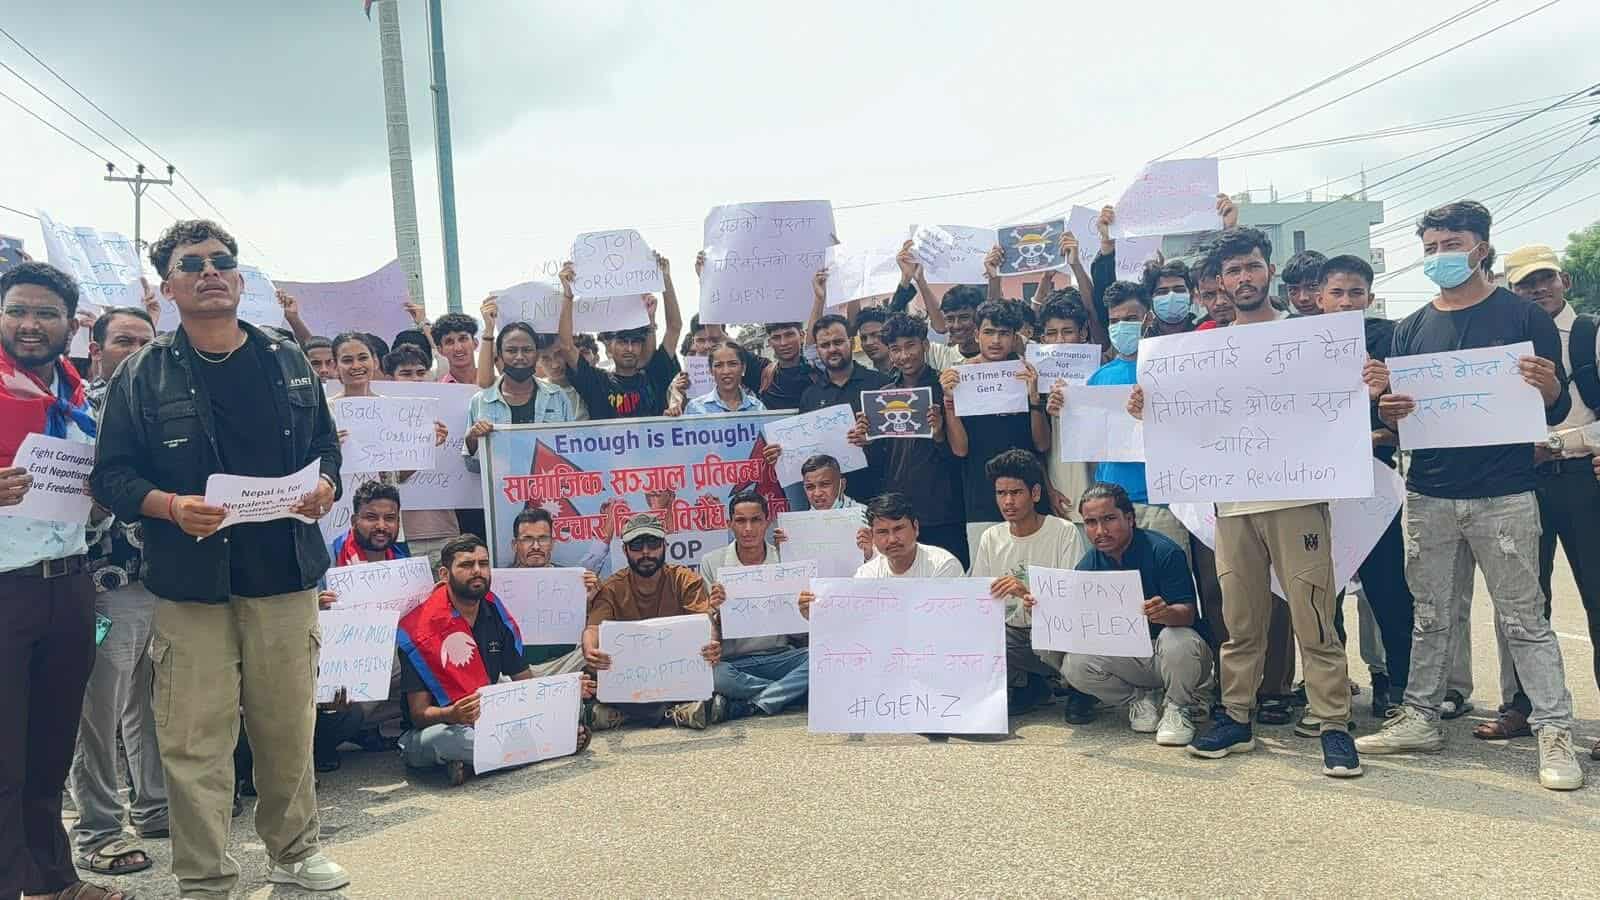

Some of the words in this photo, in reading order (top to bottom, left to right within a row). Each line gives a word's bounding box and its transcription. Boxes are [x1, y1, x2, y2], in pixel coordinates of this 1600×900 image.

[583, 231, 641, 254] STOP
[573, 269, 660, 293] CORRUPTION
[1052, 350, 1092, 360] Corruption
[1055, 361, 1070, 369] Not
[977, 371, 1000, 382] Time
[976, 384, 996, 394] Gen
[554, 429, 640, 455] Enough
[647, 430, 665, 449] is
[671, 423, 757, 451] Enough!
[31, 447, 54, 460] Fight
[29, 462, 48, 474] End
[49, 466, 90, 480] Nepotism
[1247, 456, 1336, 489] Revolution
[46, 481, 82, 495] Freedom
[241, 487, 275, 498] Nepal
[503, 464, 604, 503] सामाजिक
[610, 464, 686, 495] सञ्जाल
[1037, 575, 1068, 598] WE
[1082, 581, 1128, 608] PAY
[1042, 610, 1073, 644] YOU
[610, 627, 673, 656] STOP
[848, 692, 961, 720] #GEN-Z
